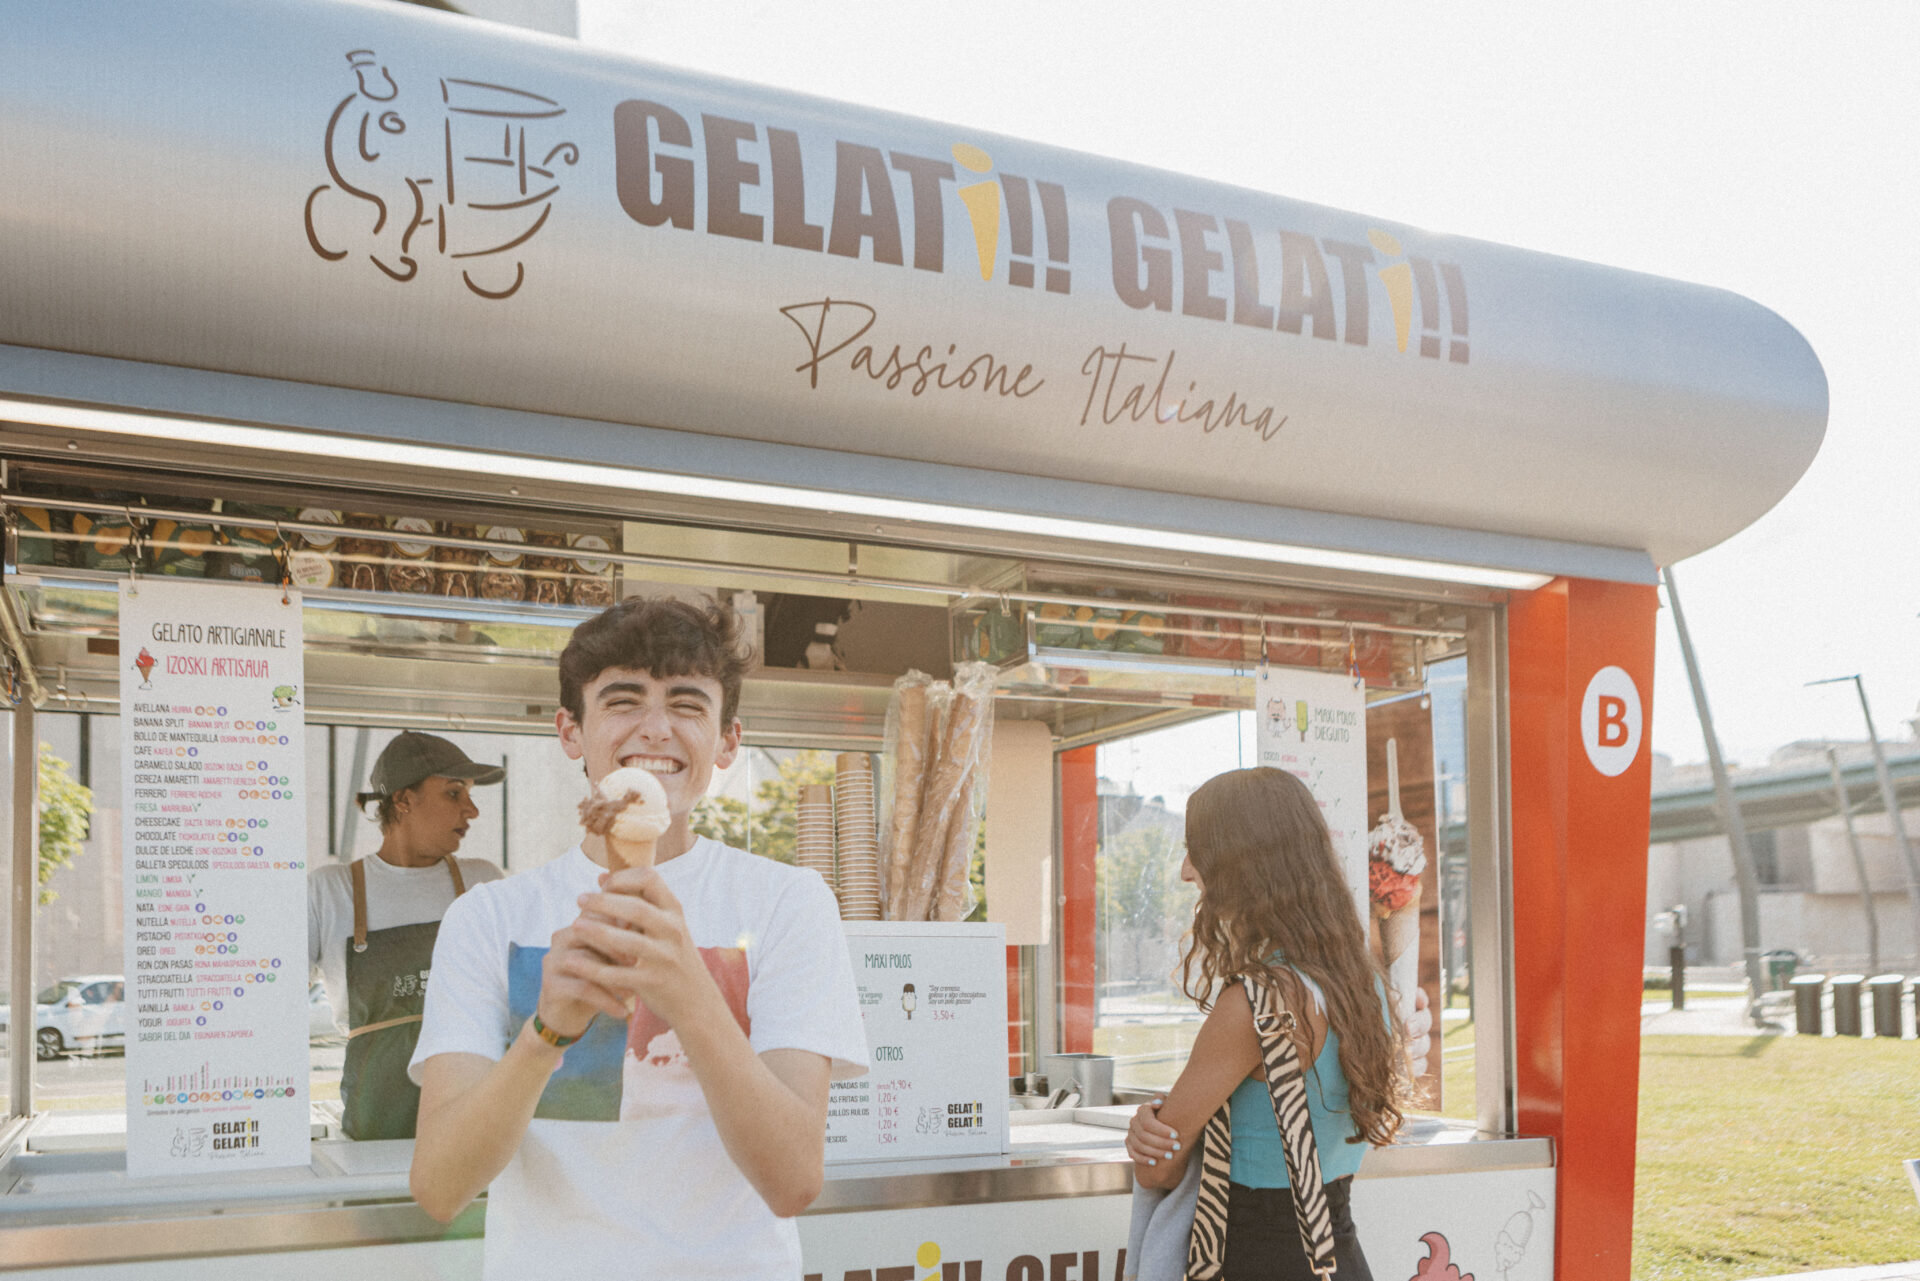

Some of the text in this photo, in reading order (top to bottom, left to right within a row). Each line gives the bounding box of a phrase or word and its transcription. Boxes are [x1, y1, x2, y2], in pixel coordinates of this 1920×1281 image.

[779, 297, 1289, 442] Passione Italiana
[152, 623, 286, 648] GELATO ARTIGIANALE
[166, 655, 206, 675] IZOSKI
[134, 704, 170, 713] AVELLANA
[1314, 708, 1357, 726] MAXI POLOS
[1598, 695, 1629, 748] B
[134, 719, 230, 729] BANANA SPLIT BANANA SPLIT
[134, 732, 157, 741] BOLLO
[158, 733, 168, 741] DE
[170, 733, 219, 743] MANTEQUILLA
[1314, 726, 1350, 743] DIEGUITO
[134, 761, 173, 770] CARAMELO
[175, 761, 203, 770] SALADO
[135, 775, 162, 784] CEREZA
[164, 775, 200, 785] AMARETTI
[203, 777, 232, 785] AMARETTI
[135, 789, 167, 798] FERRERO
[135, 803, 157, 812] FRESA
[135, 818, 181, 826] CHEESECAKE
[135, 832, 176, 841] CHOCOLATE
[135, 846, 159, 855] DULCE
[160, 846, 170, 855] DE
[171, 846, 194, 855] LECHE
[136, 860, 166, 869] GALLETA
[168, 861, 209, 869] SPECULOOS
[136, 889, 162, 898] MANGO
[136, 903, 154, 912] NATA
[136, 918, 197, 926] NUTELLA NUTELLA
[137, 932, 171, 941] PISTACHO
[137, 947, 176, 955] OREO OREO
[137, 961, 153, 969] RON
[154, 961, 169, 969] CON
[170, 960, 193, 969] PASAS
[865, 954, 912, 968] MAXI POLOS
[137, 974, 242, 984] STRACCIATELLA STRACCIATELLA
[137, 987, 231, 999] TUTTI FRUTTI TUTTI FRUTTI
[138, 1003, 170, 1013] VAINILLA
[138, 1018, 162, 1027] YOGUR
[138, 1032, 162, 1042] SABOR
[164, 1032, 178, 1041] DEL
[876, 1046, 904, 1061] OTROS
